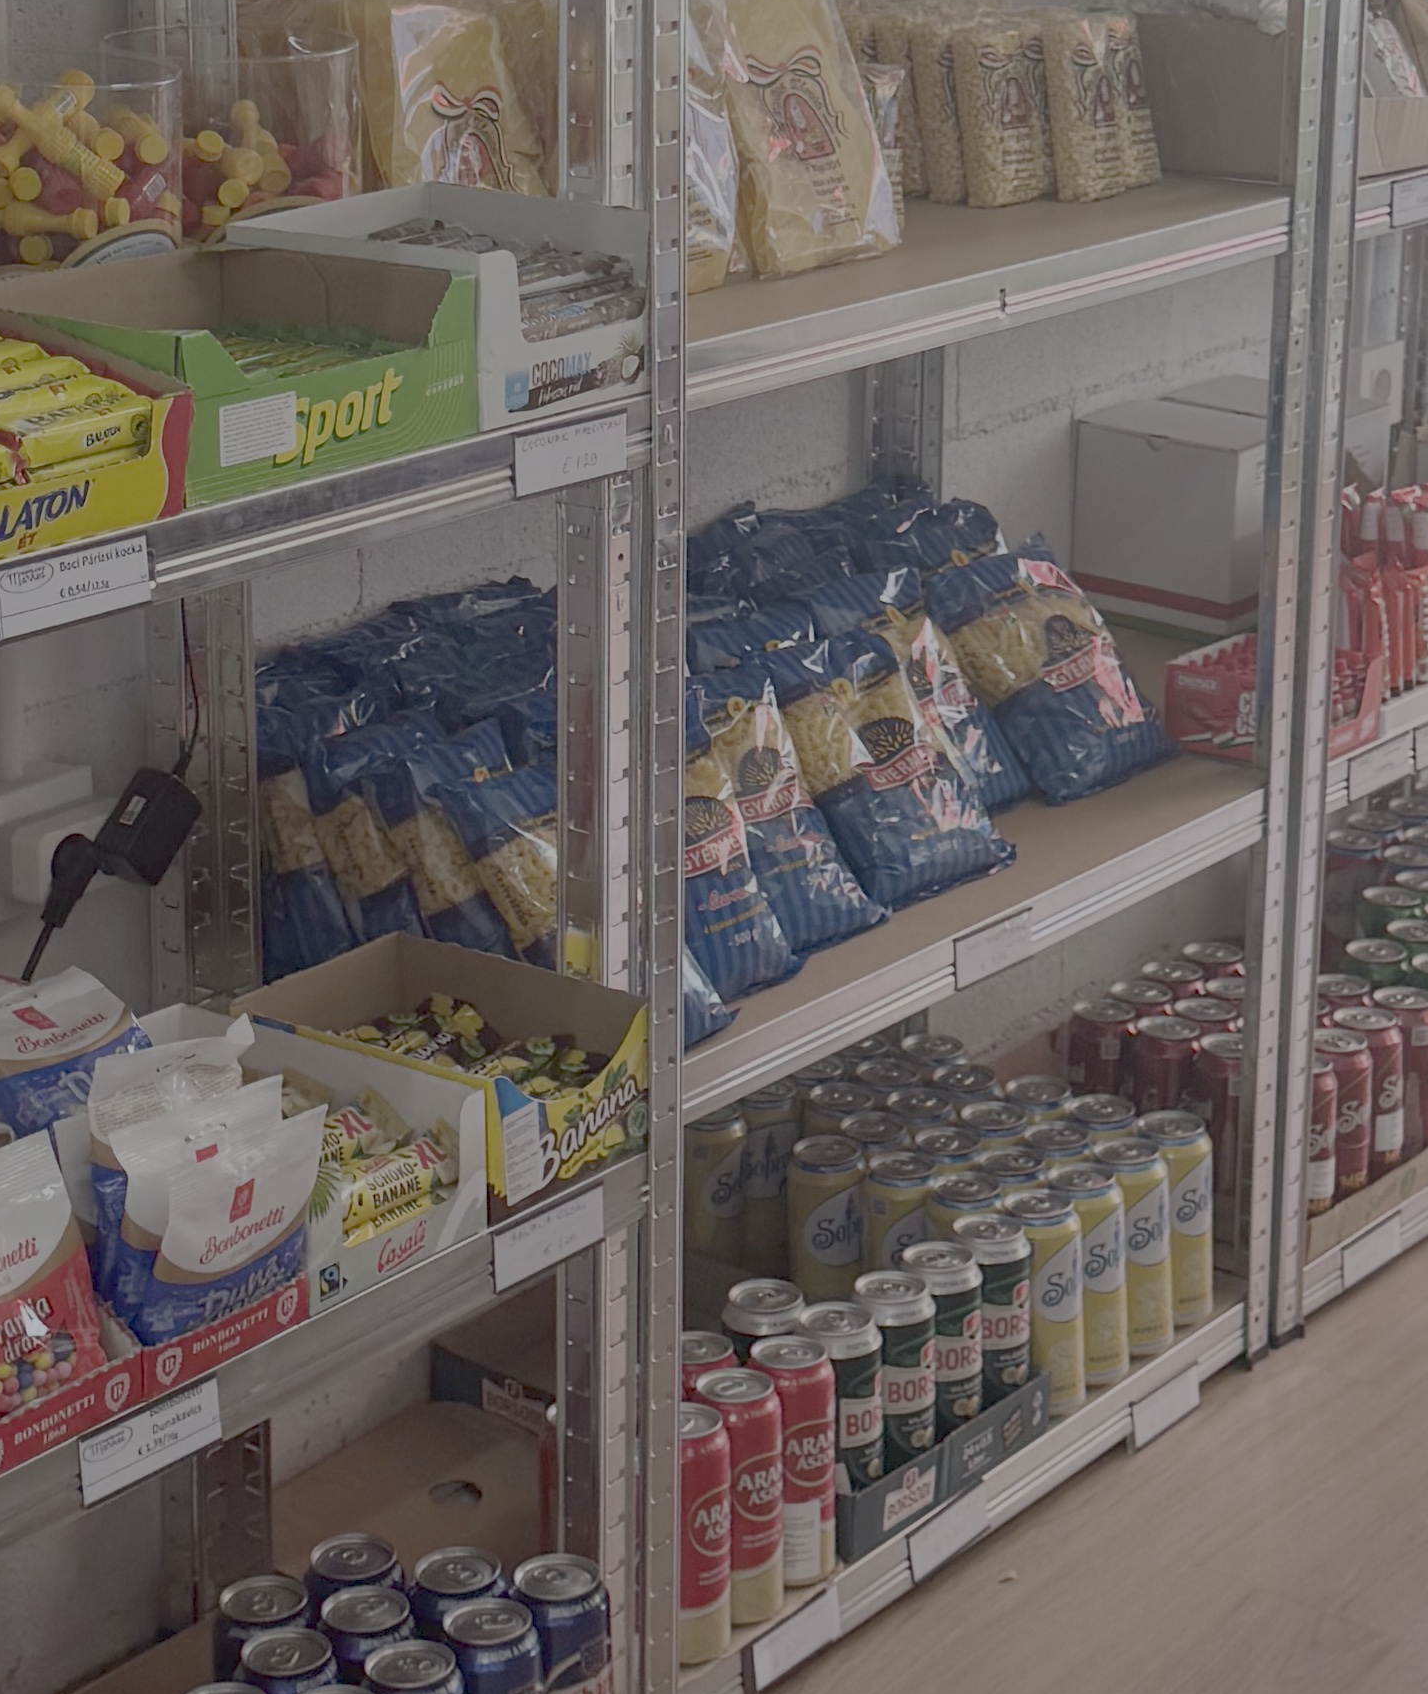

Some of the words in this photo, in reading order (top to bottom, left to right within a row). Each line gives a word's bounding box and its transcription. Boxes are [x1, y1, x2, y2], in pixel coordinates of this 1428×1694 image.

[275, 366, 405, 466] Sport
[14, 1011, 108, 1055] Bonbonetti
[339, 1109, 374, 1140] XL
[539, 1077, 640, 1186] Banana
[366, 1162, 418, 1192] SCHOKO-
[415, 1137, 447, 1171] XL
[372, 1175, 423, 1207] BANANE
[199, 1205, 286, 1266] Bonbonetti
[191, 1307, 270, 1356] BONBONETTI
[13, 1392, 97, 1446] BONBONETTI
